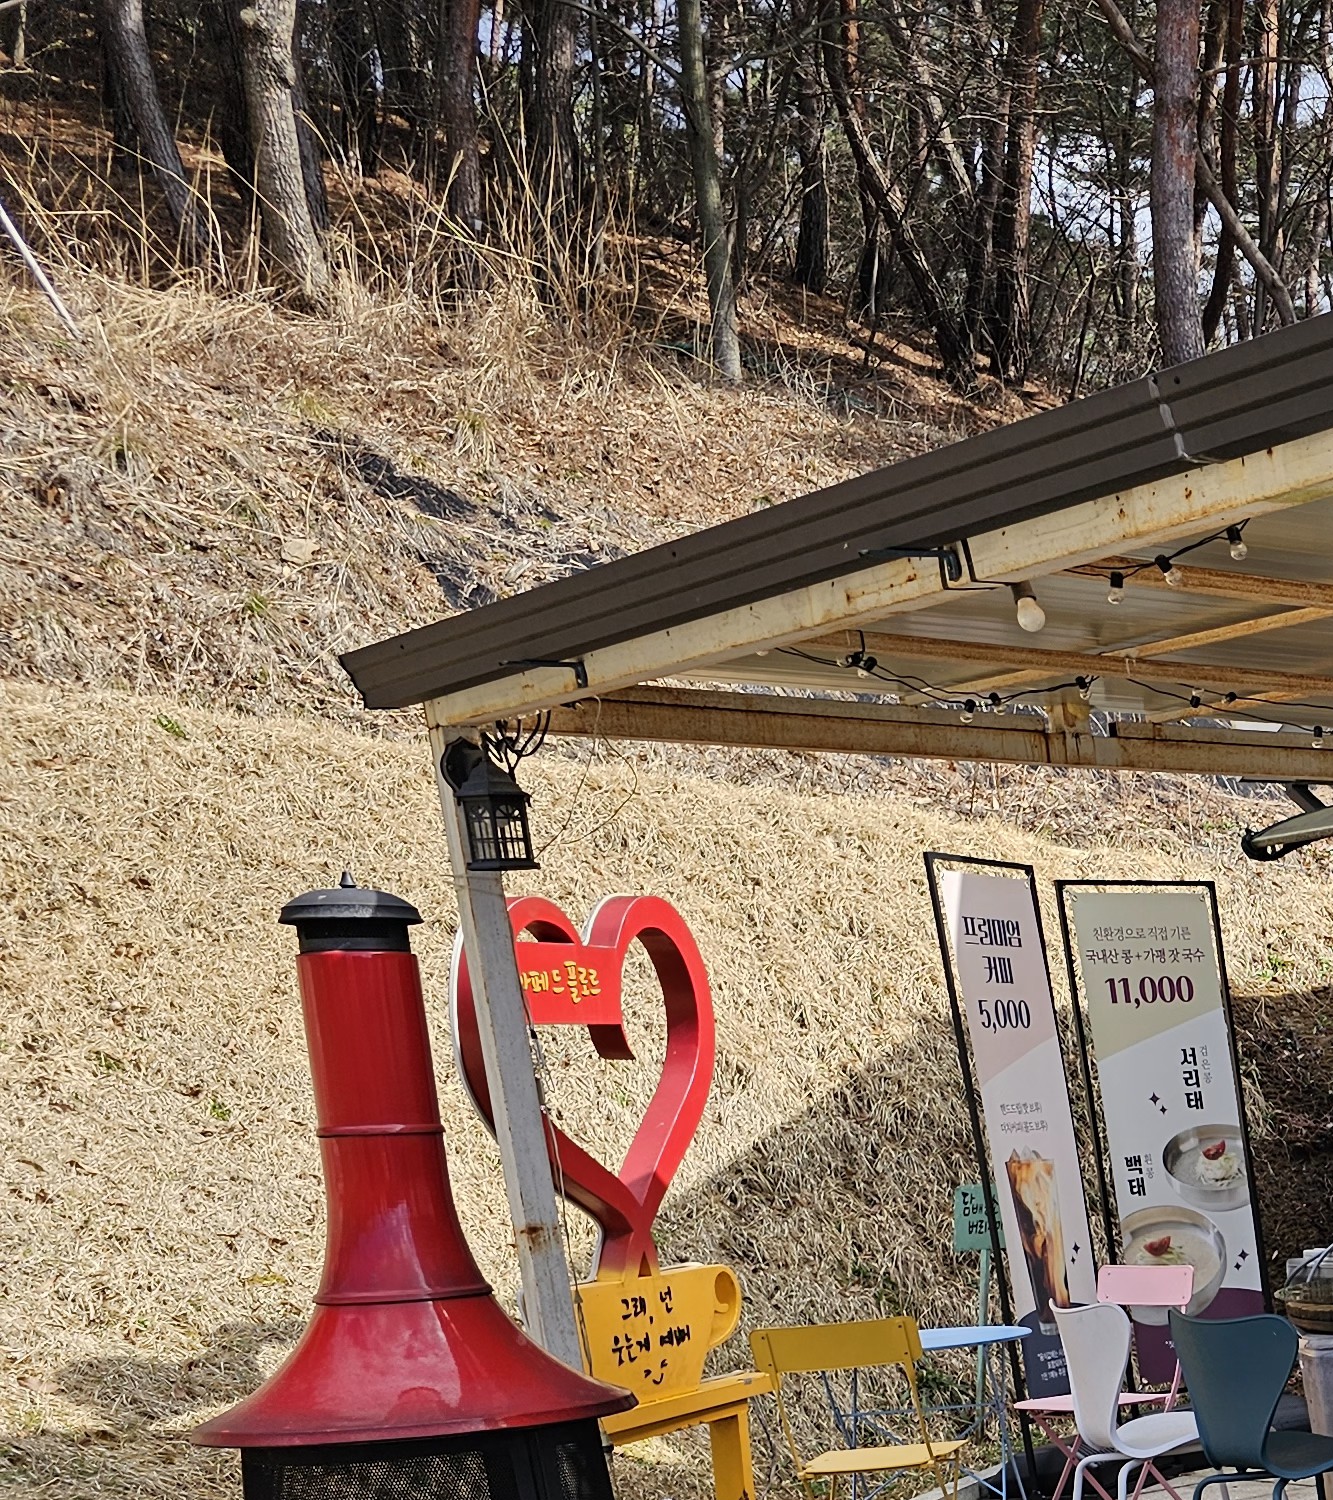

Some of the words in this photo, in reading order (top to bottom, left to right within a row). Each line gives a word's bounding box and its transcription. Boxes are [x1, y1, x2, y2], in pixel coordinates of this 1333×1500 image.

[961, 915, 1022, 948] 프리미엄
[1093, 926, 1146, 942] 친환경으로
[1147, 925, 1169, 941] 직접
[1170, 925, 1192, 941] 기른
[982, 955, 1014, 985] 커피
[1085, 948, 1119, 965] 국내산
[1120, 949, 1134, 965] 콩
[1143, 947, 1167, 964] 가평
[1168, 947, 1181, 964] 잣
[1181, 947, 1206, 964] 국수
[1104, 975, 1195, 1010] 11,000
[978, 999, 1031, 1034] 5,000
[1179, 1047, 1205, 1110] 서리태
[1124, 1154, 1147, 1197] 백태
[659, 1285, 673, 1314] 넌
